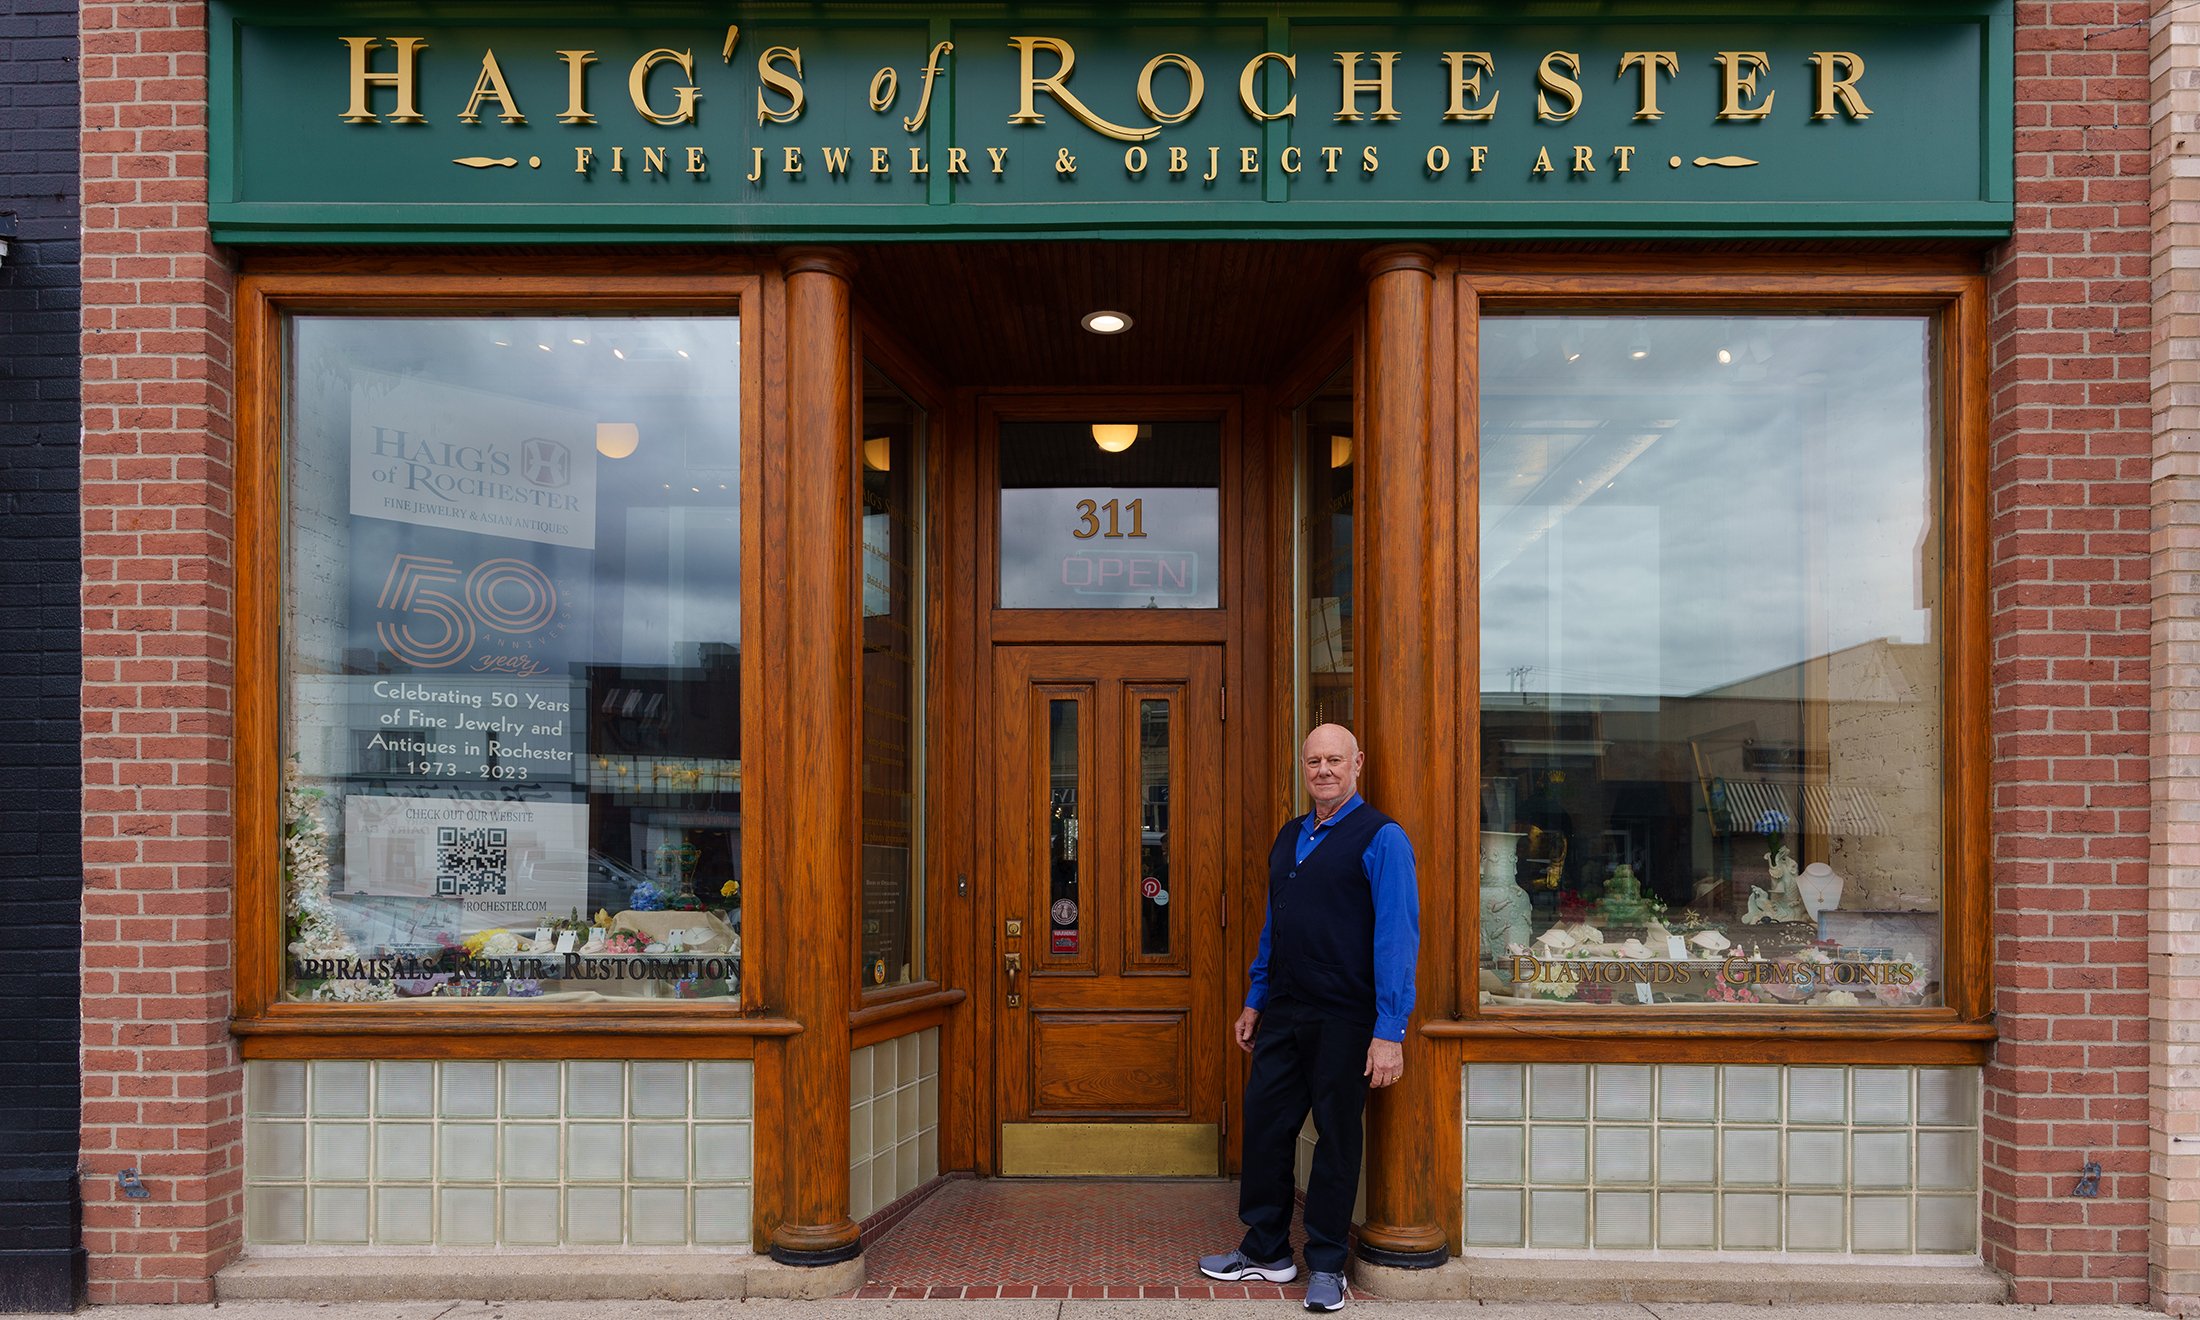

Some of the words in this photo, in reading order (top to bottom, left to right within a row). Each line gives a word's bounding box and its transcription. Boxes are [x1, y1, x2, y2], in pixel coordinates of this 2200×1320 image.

[338, 25, 805, 127] HAIG'S
[868, 41, 954, 132] of
[1007, 36, 1875, 142] ROCHESTER
[575, 146, 706, 174] FINE
[747, 146, 1009, 182] JEWELRY
[1055, 146, 1077, 174] &
[1124, 146, 1380, 181] OBJECTS
[1427, 146, 1488, 173] OF
[1532, 146, 1636, 174] ART
[370, 425, 511, 477] HAIG'S
[372, 466, 397, 484] of
[404, 462, 581, 513] ROCHESTER
[384, 496, 411, 512] FINE
[412, 501, 467, 519] JEWELRY
[469, 512, 478, 521] &
[481, 513, 513, 526] ASIAN
[512, 518, 569, 535] ANTIQUES
[1072, 498, 1148, 539] 311
[1062, 557, 1186, 588] OPEN
[376, 553, 557, 669] 50
[373, 680, 483, 709] Celebrating
[491, 691, 519, 709] 50
[525, 692, 570, 713] Years
[380, 709, 401, 726] of
[409, 711, 448, 729] Fine
[453, 713, 525, 736] Jewelry
[531, 720, 562, 737] and
[367, 733, 457, 757] Antiques
[464, 739, 481, 756] in
[488, 739, 574, 762] Rochester
[407, 760, 457, 777] 1973
[480, 763, 529, 780] 2023
[405, 808, 441, 821] CHECK
[443, 809, 465, 821] OUT
[466, 810, 489, 822] OUR
[489, 811, 534, 823] WEBSITE
[453, 952, 549, 980] REPAIR
[562, 952, 741, 980] RESTORATION
[1511, 955, 1691, 985] DIAMONDS
[1722, 955, 1915, 986] GEMSTONES
